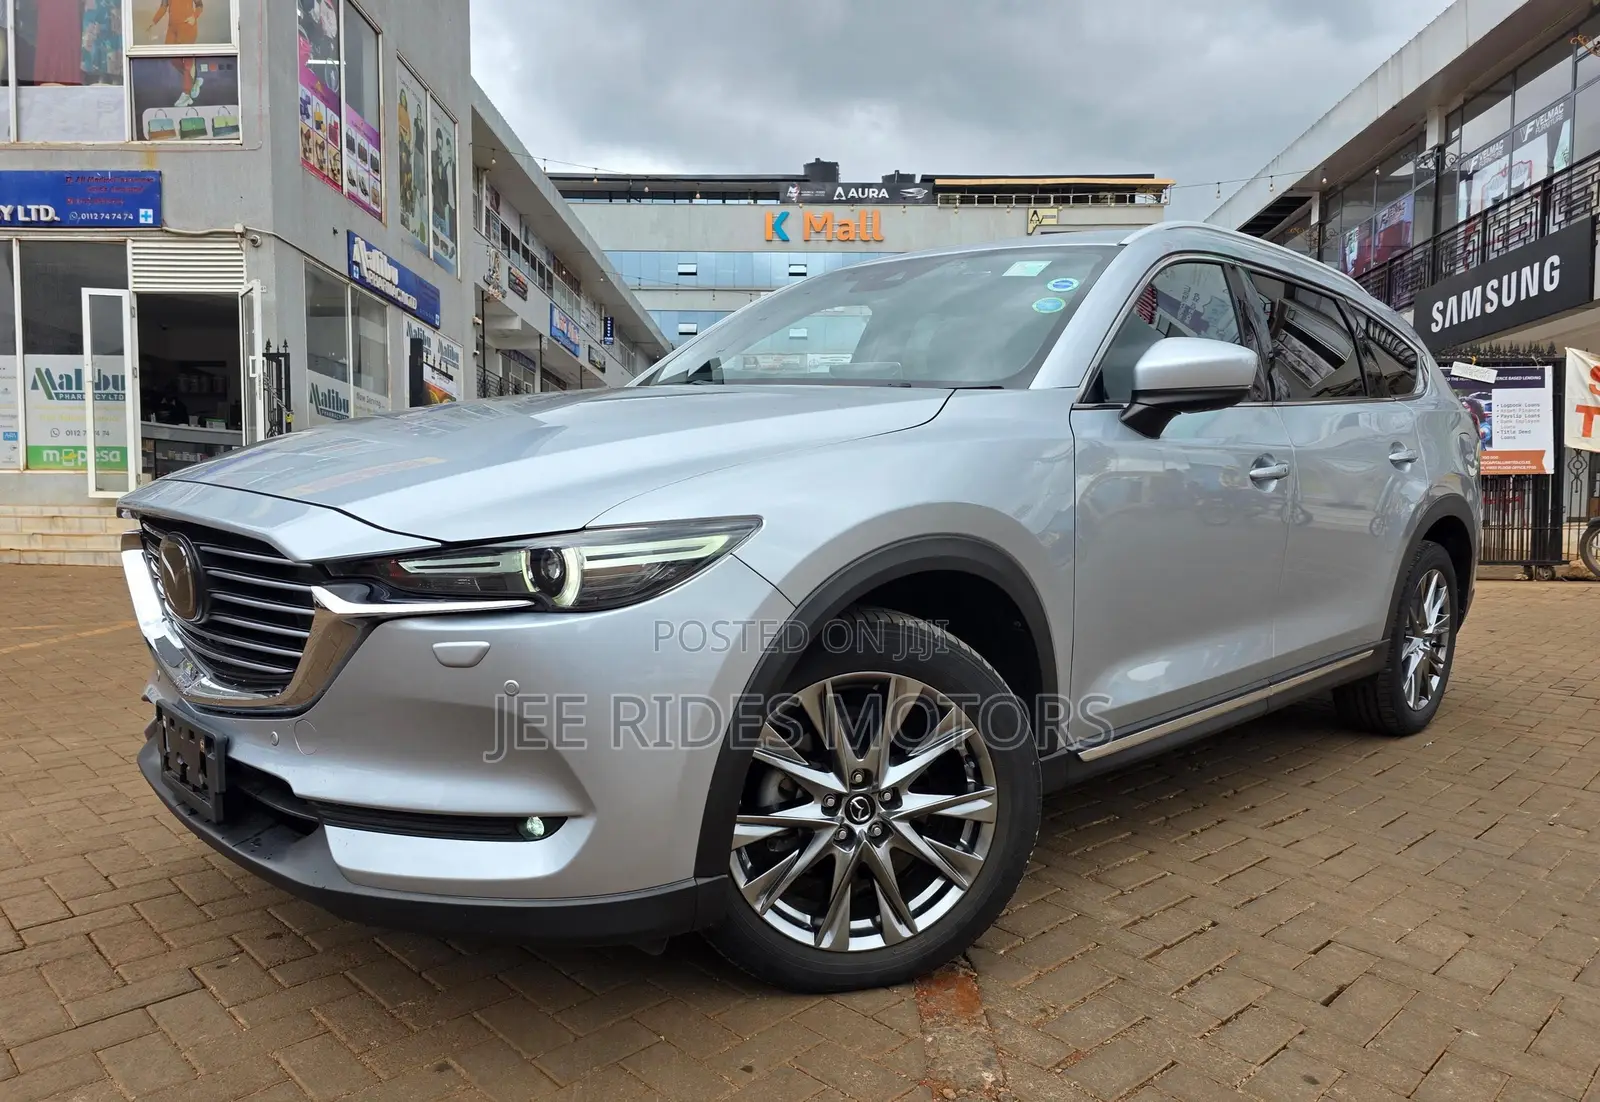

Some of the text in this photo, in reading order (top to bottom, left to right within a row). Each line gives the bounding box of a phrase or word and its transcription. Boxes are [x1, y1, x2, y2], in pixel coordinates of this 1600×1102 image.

[1535, 103, 1564, 127] VELMAC
[1536, 113, 1564, 134] FURNITURE
[1480, 140, 1504, 161] VELMAC
[848, 187, 889, 199] AURA
[0, 204, 60, 222] Y LTD.
[765, 209, 884, 242] K Mall
[1431, 254, 1560, 333] SAMSUNG
[31, 367, 126, 400] Malbu
[310, 382, 349, 415] Malibu
